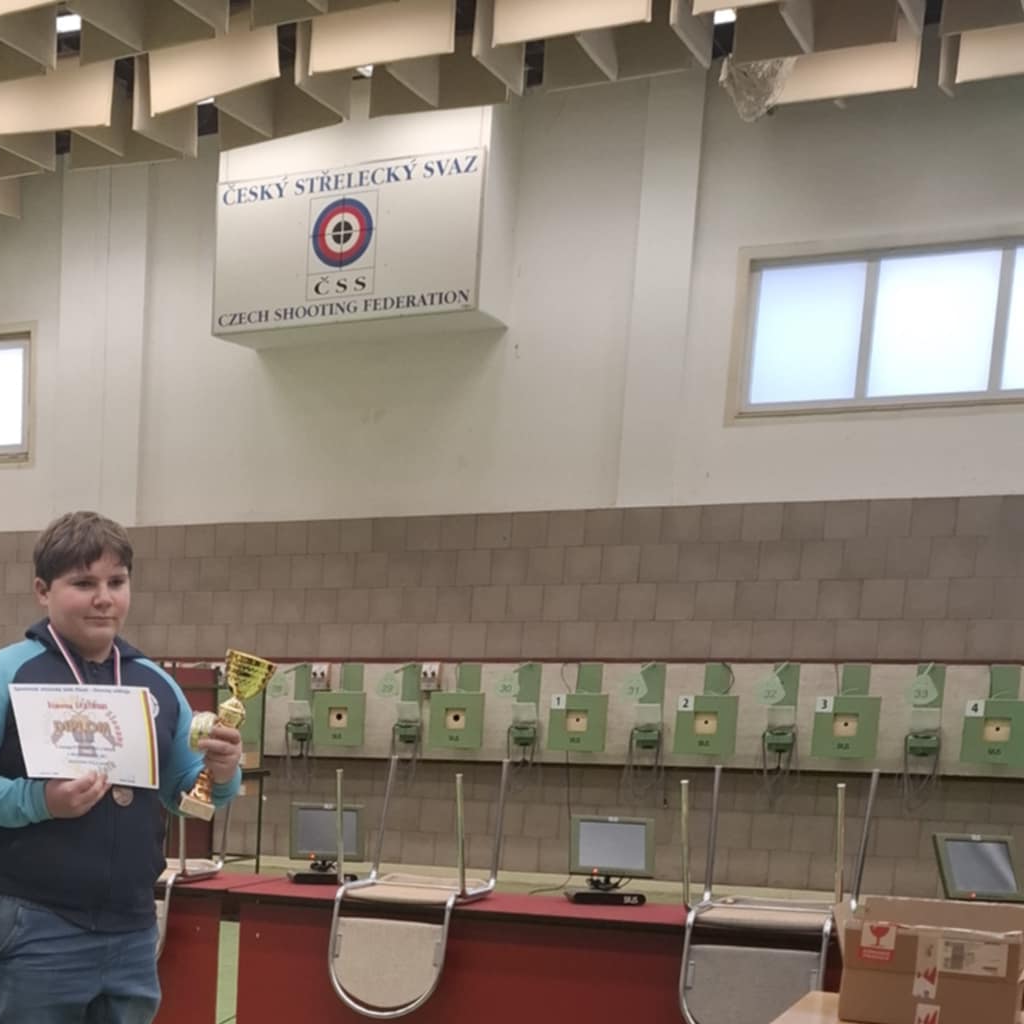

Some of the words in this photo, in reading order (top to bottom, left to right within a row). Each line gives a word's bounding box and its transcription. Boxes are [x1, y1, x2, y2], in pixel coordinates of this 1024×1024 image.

[222, 176, 289, 206] ČESKÝ
[294, 159, 417, 195] STŘELECKÝ
[422, 154, 478, 179] SVAZ
[217, 308, 269, 328] CZECH
[273, 300, 358, 322] SHOOTING
[363, 290, 470, 312] FEDERATION
[682, 698, 690, 709] 2
[820, 699, 828, 710] 3
[971, 703, 979, 713] 4
